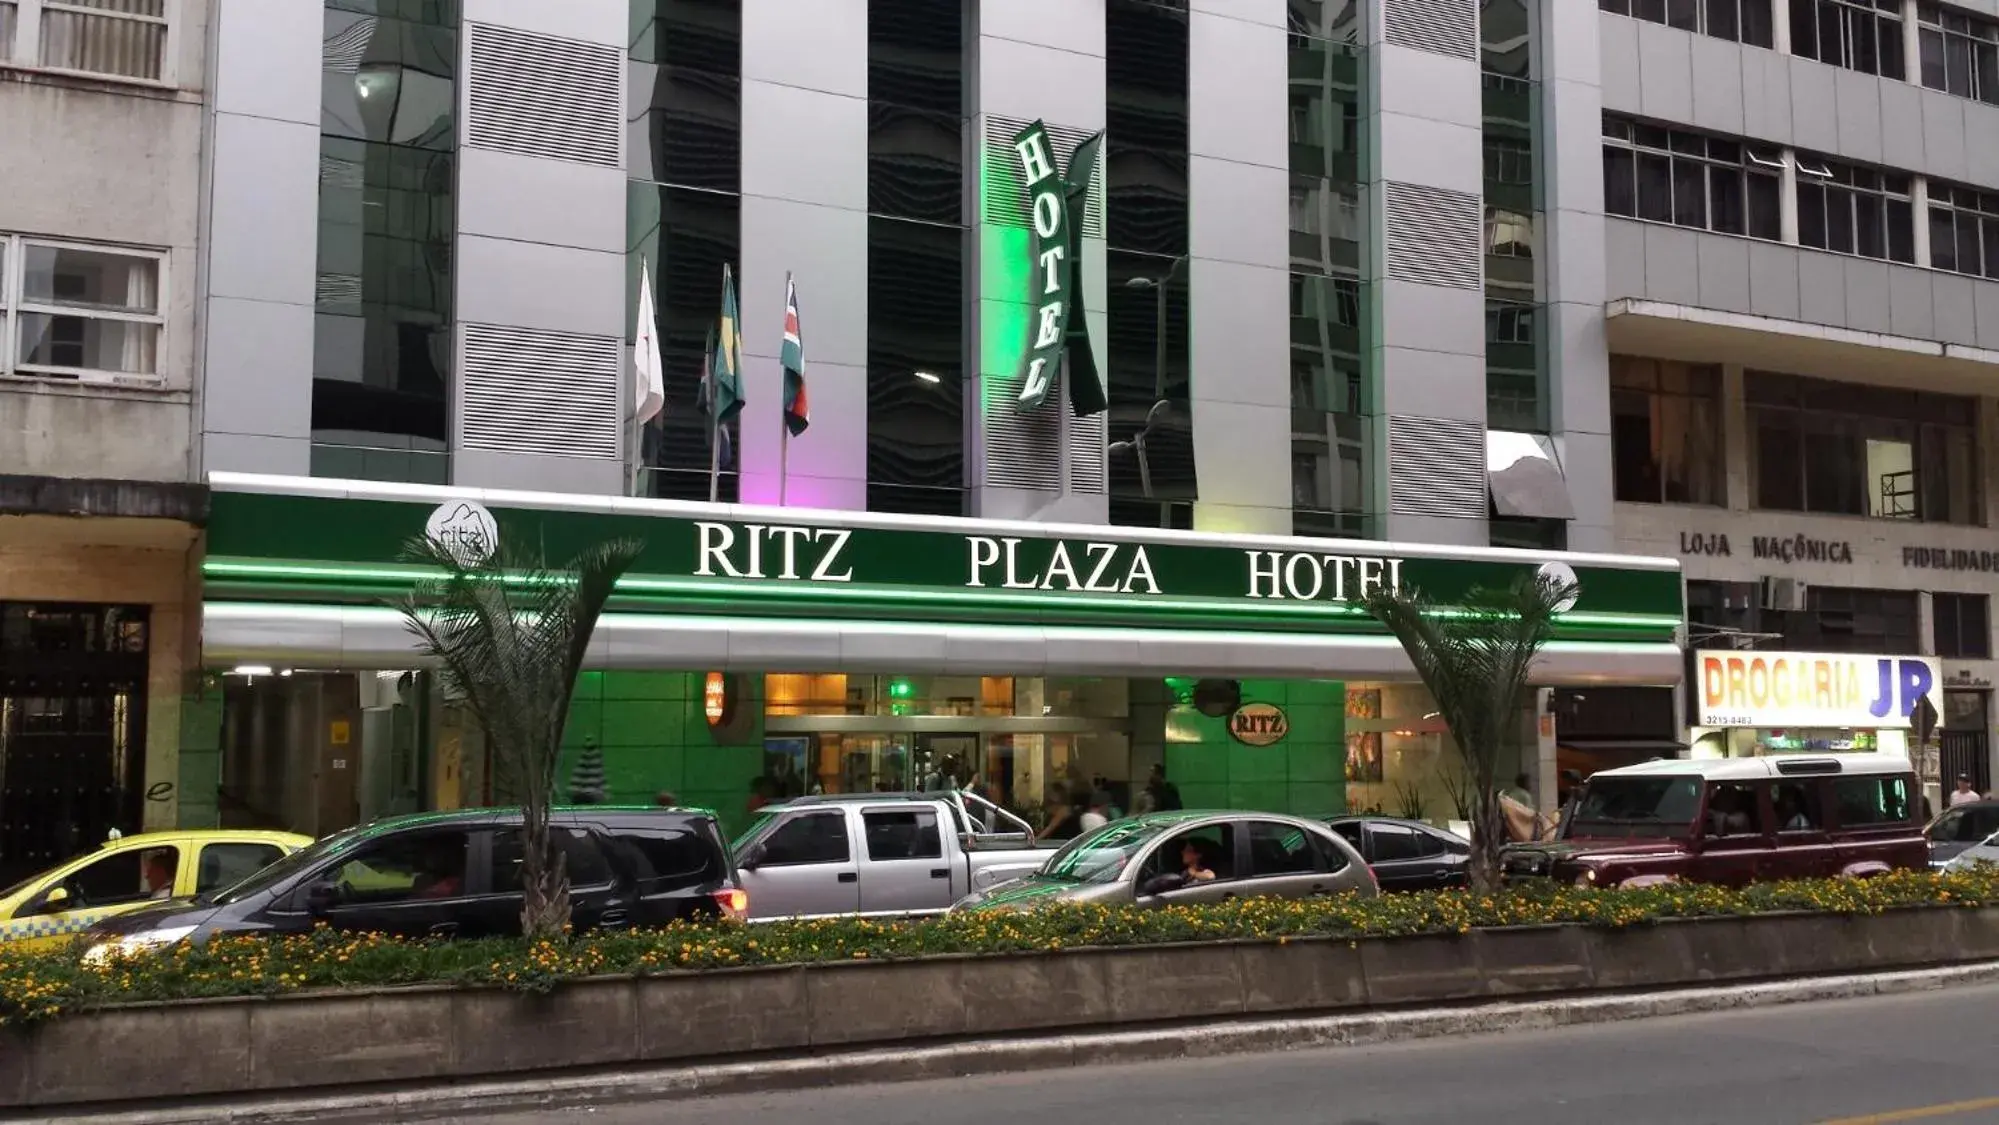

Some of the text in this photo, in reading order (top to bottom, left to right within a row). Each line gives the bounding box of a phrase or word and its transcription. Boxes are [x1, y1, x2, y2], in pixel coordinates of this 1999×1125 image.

[1016, 131, 1064, 401] HOTEL
[692, 521, 854, 582] RITZ
[964, 535, 1163, 594] PLAZA
[1680, 531, 1732, 558] LOJA
[1704, 656, 1933, 719] DROGARIA JR
[1236, 713, 1282, 733] RITZ
